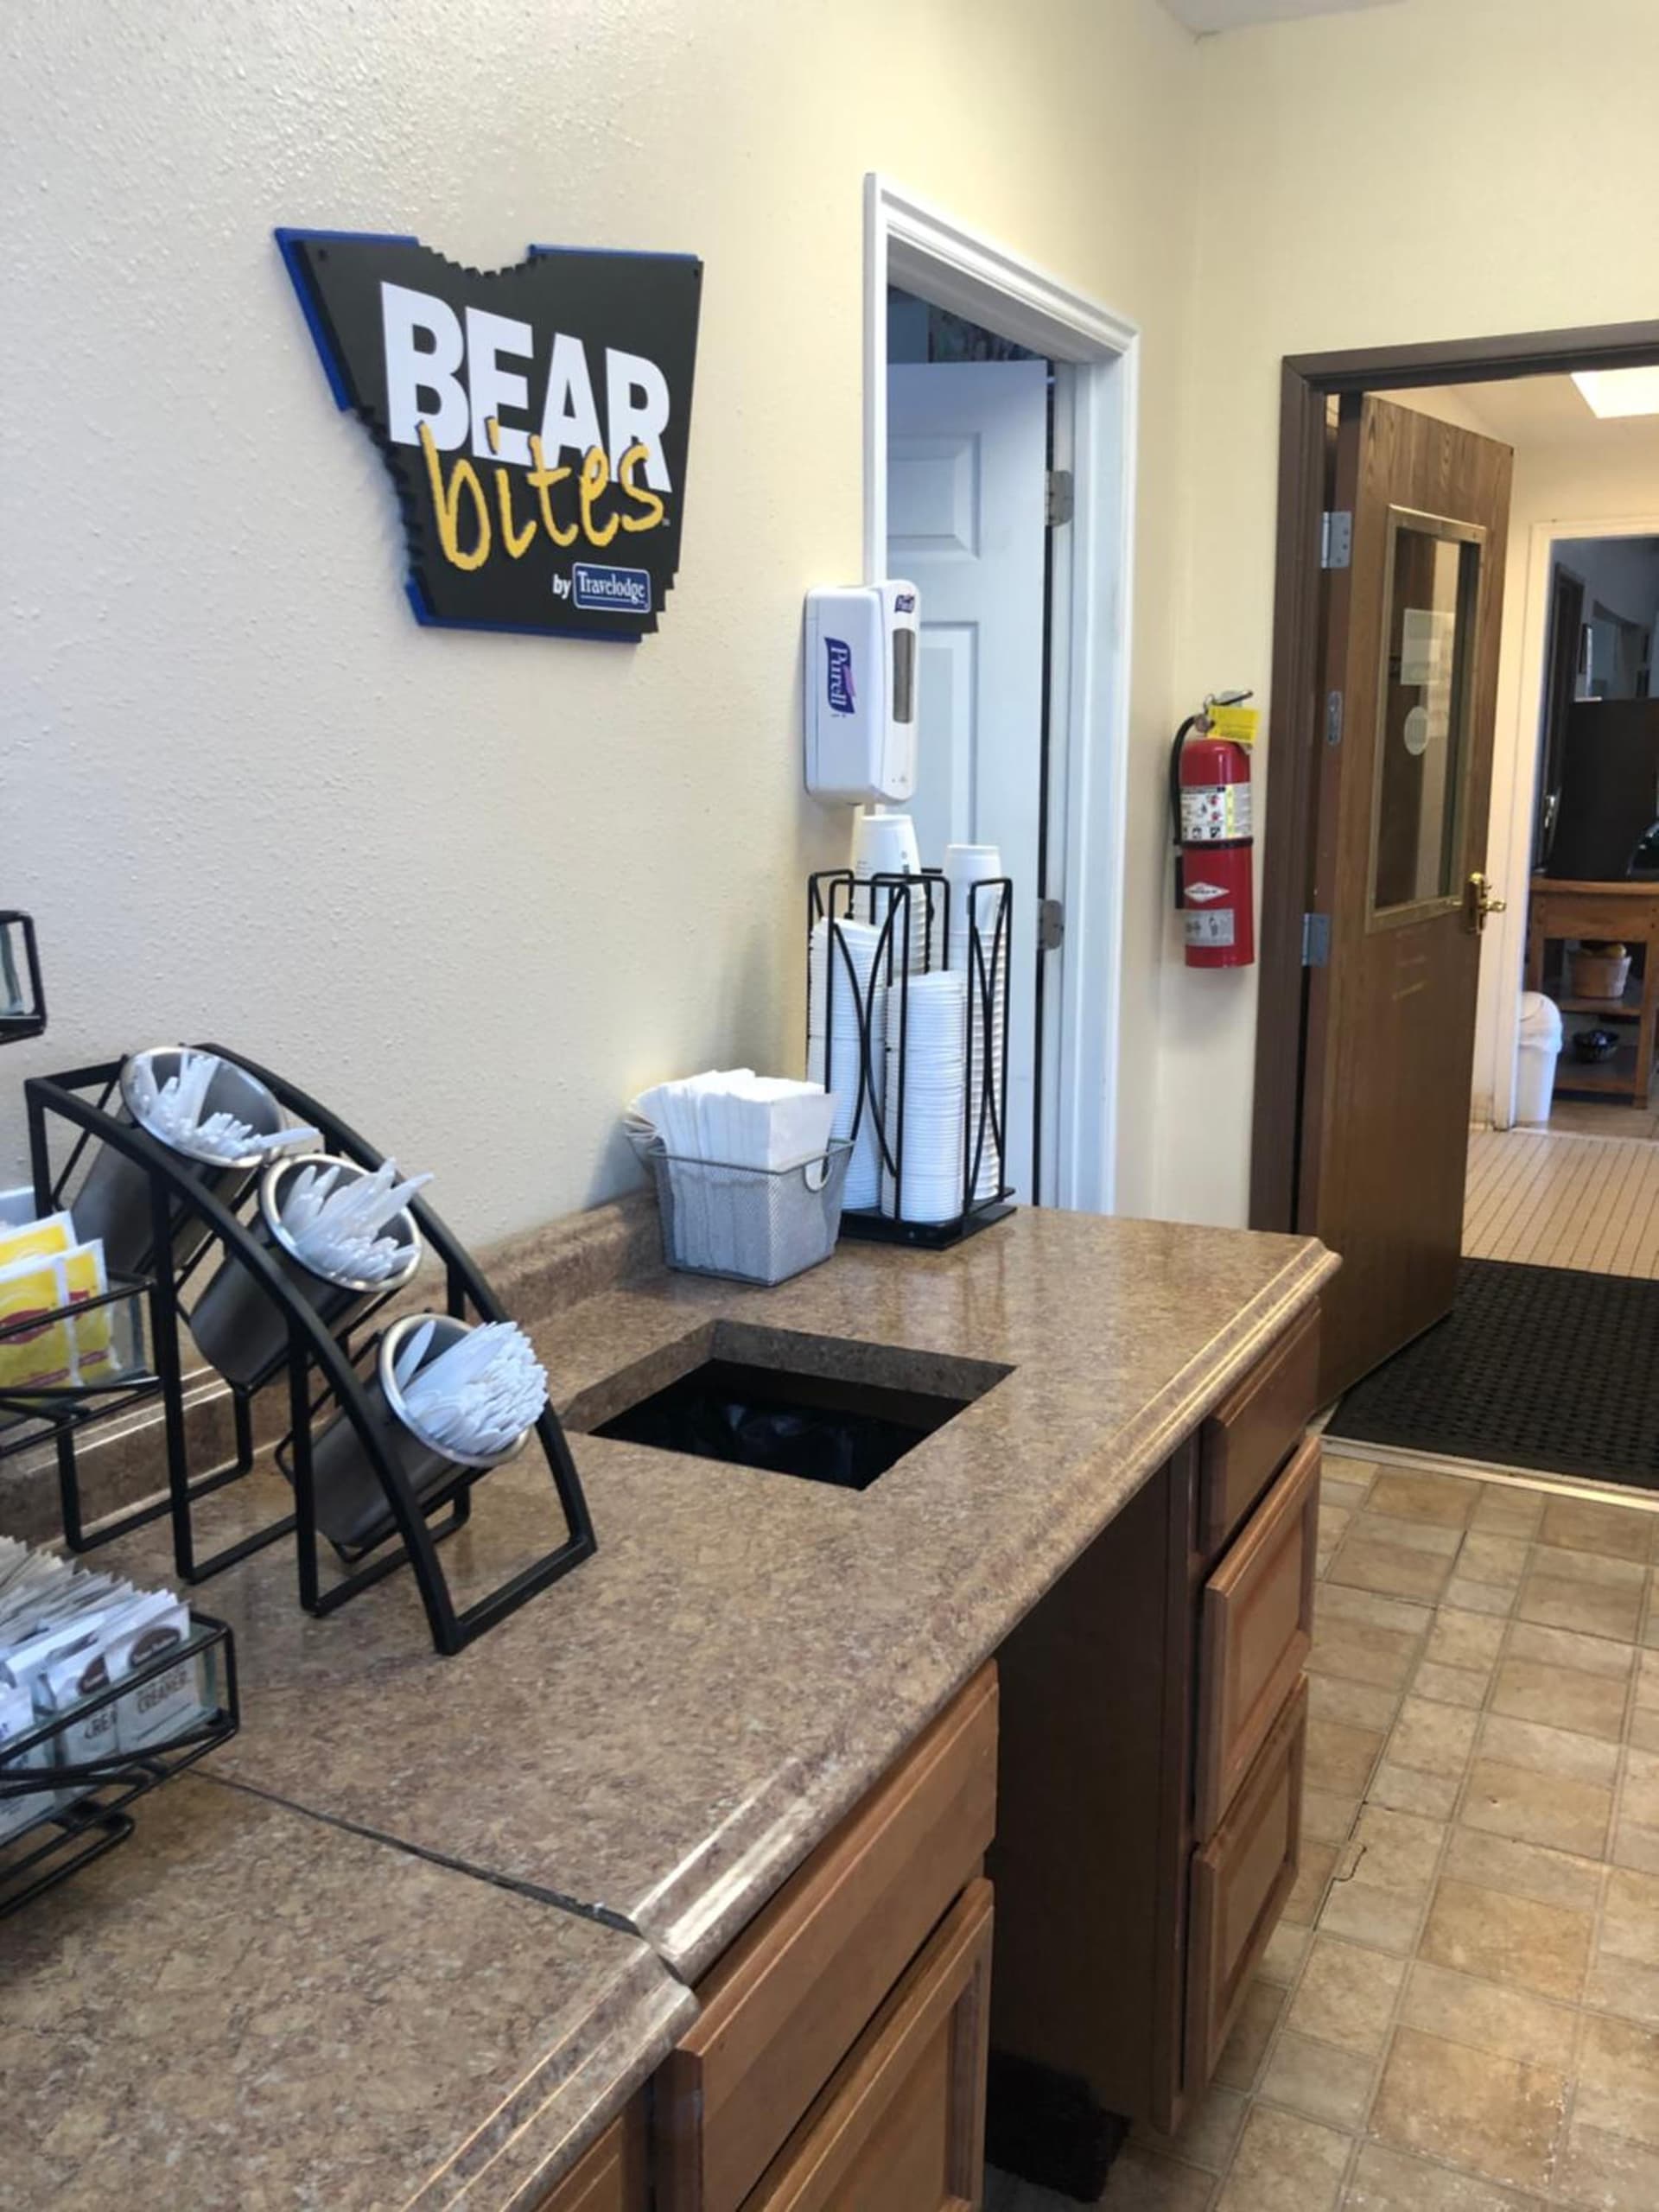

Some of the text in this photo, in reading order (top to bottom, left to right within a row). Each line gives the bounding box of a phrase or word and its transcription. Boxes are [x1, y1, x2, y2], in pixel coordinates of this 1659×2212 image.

[380, 280, 673, 493] BEAR
[416, 416, 664, 570] bites
[553, 570, 645, 604] by Travelodge
[830, 646, 848, 706] Purell
